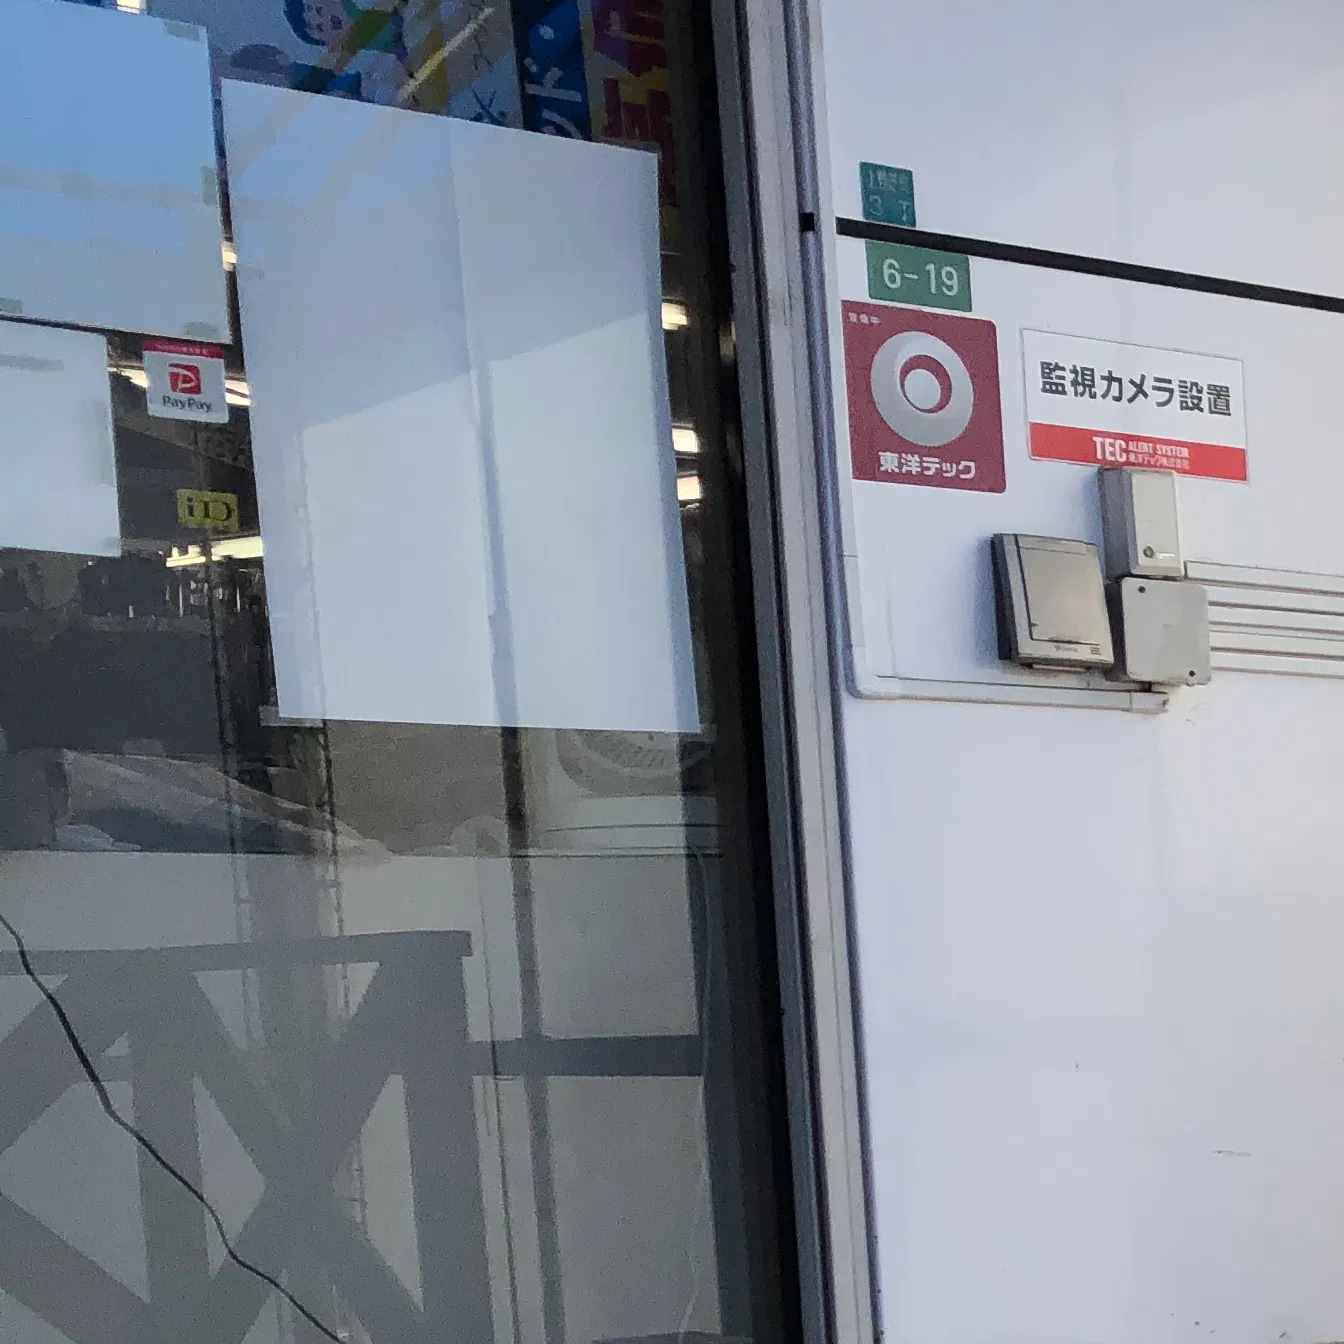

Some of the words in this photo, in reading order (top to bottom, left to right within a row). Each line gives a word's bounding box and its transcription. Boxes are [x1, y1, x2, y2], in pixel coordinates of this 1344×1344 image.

[882, 257, 959, 297] 6-19
[1039, 360, 1232, 417] 監視カメラ設置
[161, 393, 213, 413] PayPay
[1092, 436, 1127, 462] TEC
[1128, 440, 1153, 454] ALERT
[1155, 444, 1190, 459] SYSTEM
[878, 451, 977, 480] 東洋テック
[186, 495, 233, 522] iD
